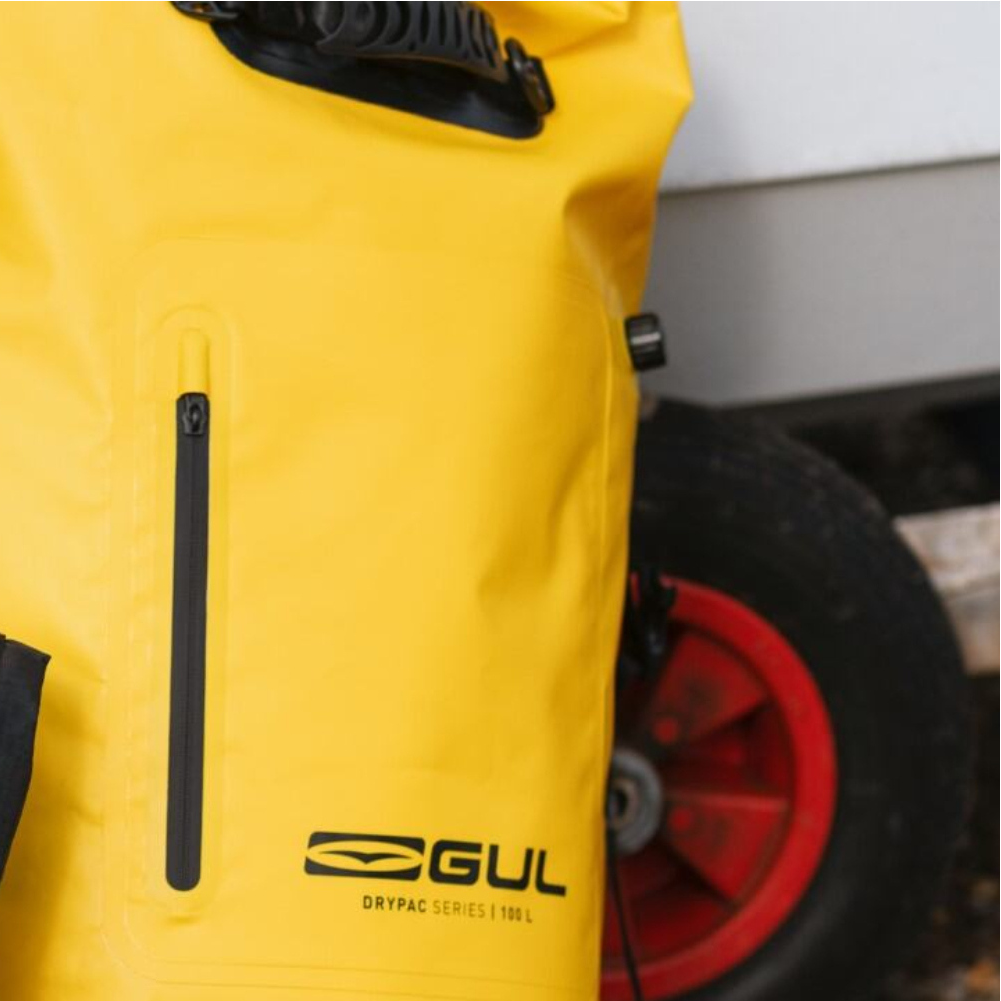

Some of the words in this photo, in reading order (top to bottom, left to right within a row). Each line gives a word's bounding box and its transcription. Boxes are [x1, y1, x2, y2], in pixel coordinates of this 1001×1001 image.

[428, 839, 566, 896] GUL
[362, 894, 428, 914] DRYPAC
[432, 899, 487, 919] SERIES
[501, 905, 523, 922] 100
[525, 909, 533, 923] L
